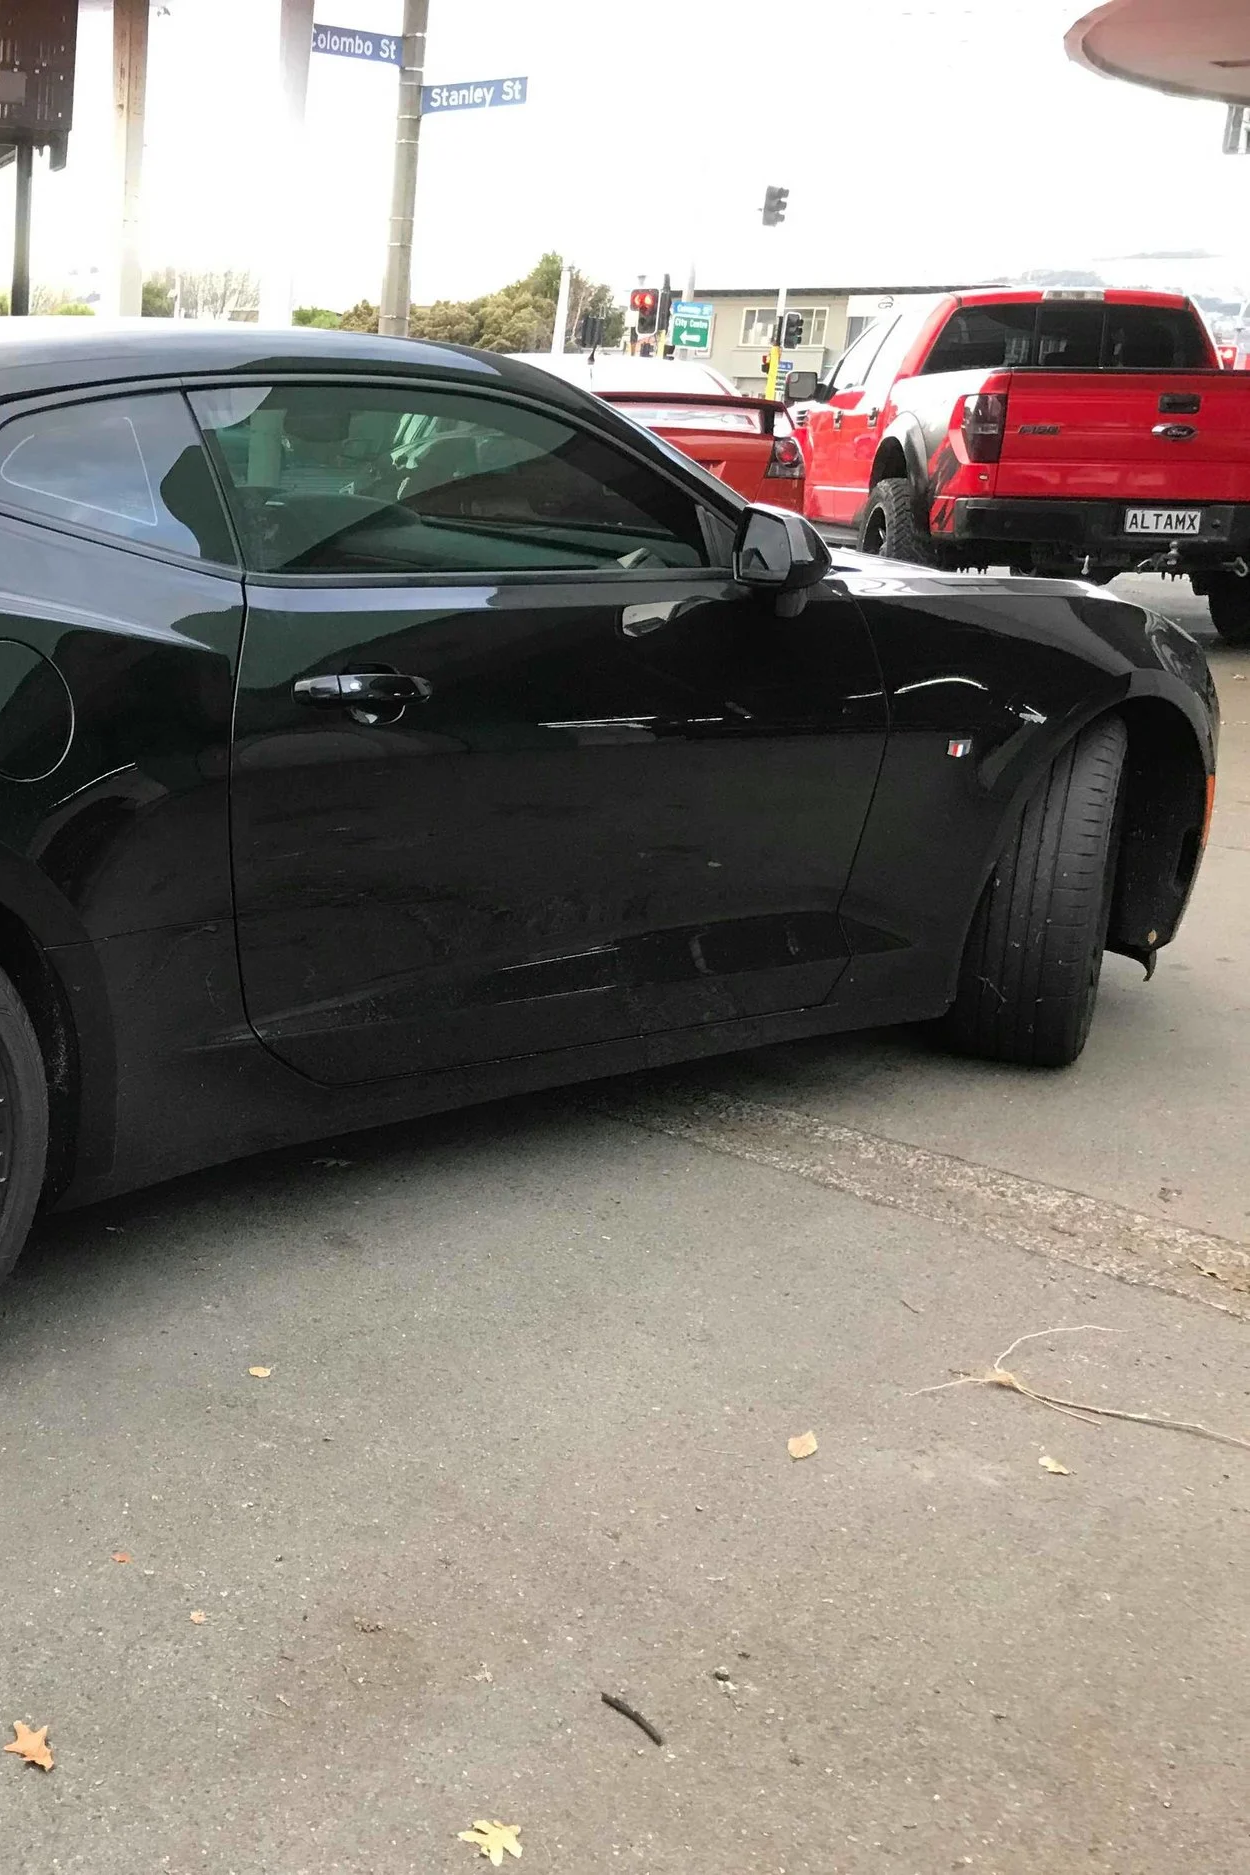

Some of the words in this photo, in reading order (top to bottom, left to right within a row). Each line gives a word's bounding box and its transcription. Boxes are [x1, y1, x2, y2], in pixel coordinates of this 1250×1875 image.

[379, 38, 397, 60] St
[430, 84, 495, 108] Stanley
[501, 80, 522, 101] St
[1129, 513, 1198, 530] ALTAMX
